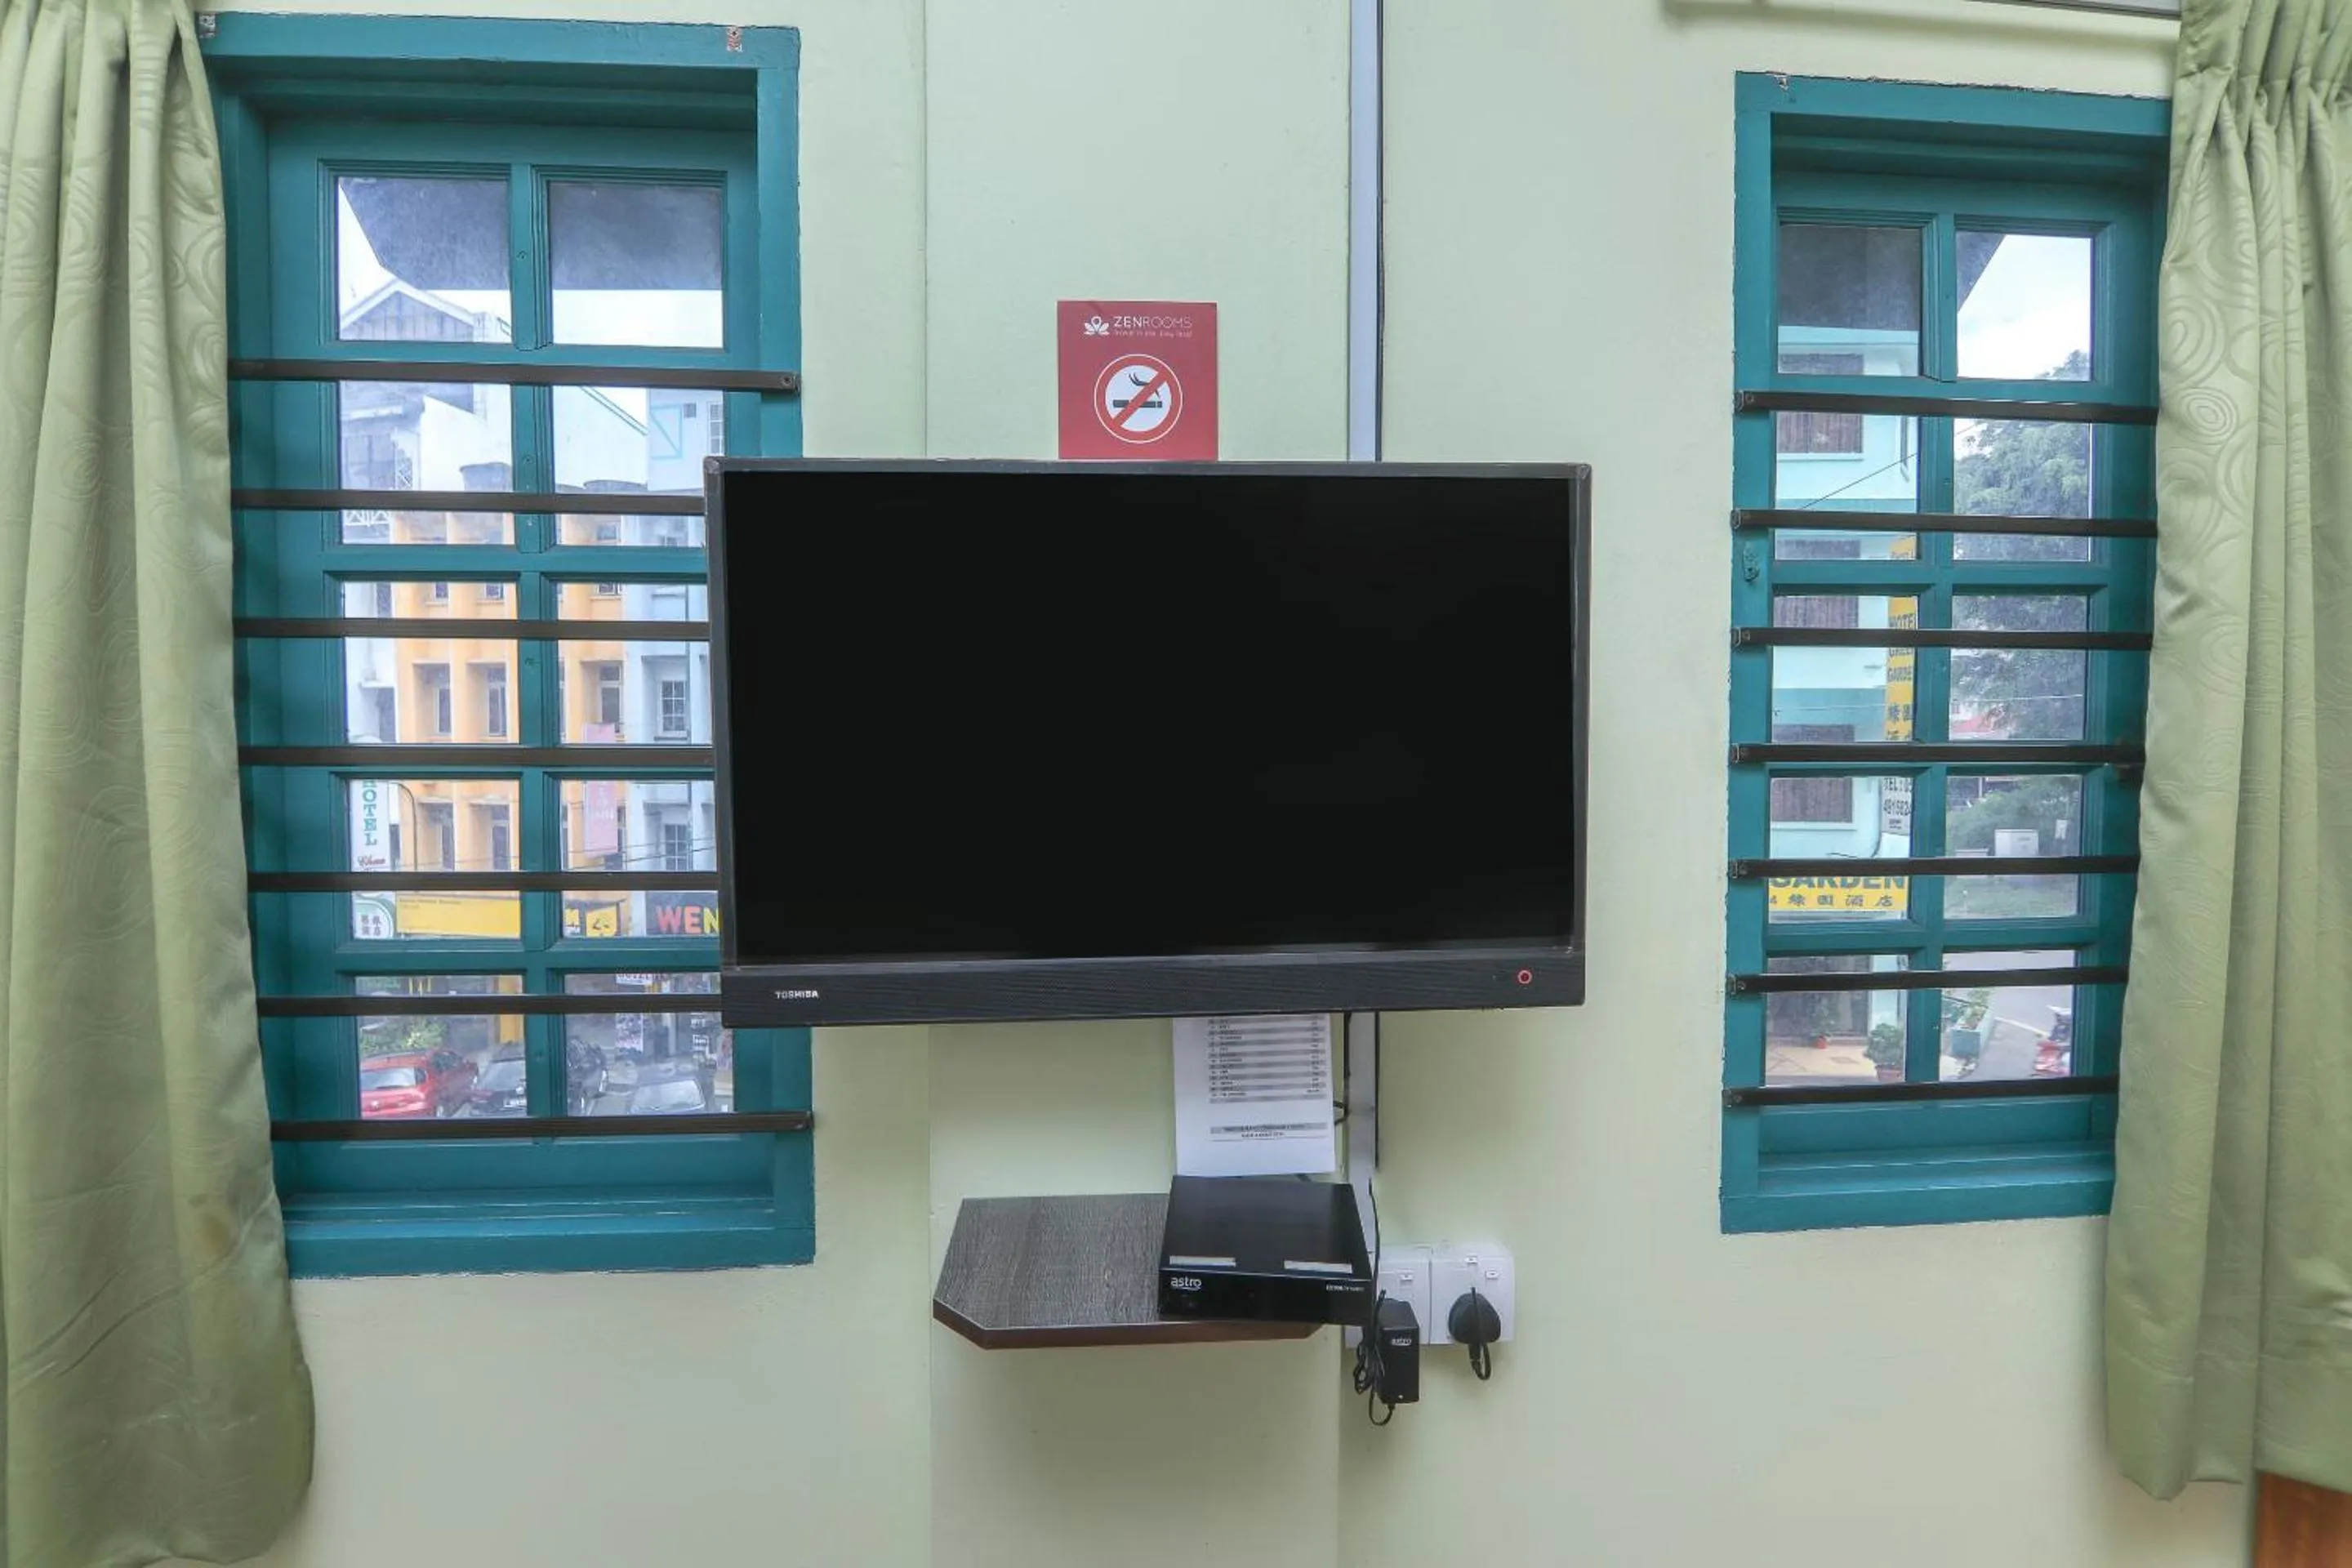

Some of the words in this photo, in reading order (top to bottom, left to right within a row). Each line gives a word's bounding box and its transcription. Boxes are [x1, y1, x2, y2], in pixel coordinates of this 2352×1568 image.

[1112, 315, 1192, 328] ZENROOMS
[774, 990, 819, 1000] TOSHIBA
[1170, 1276, 1202, 1290] astro
